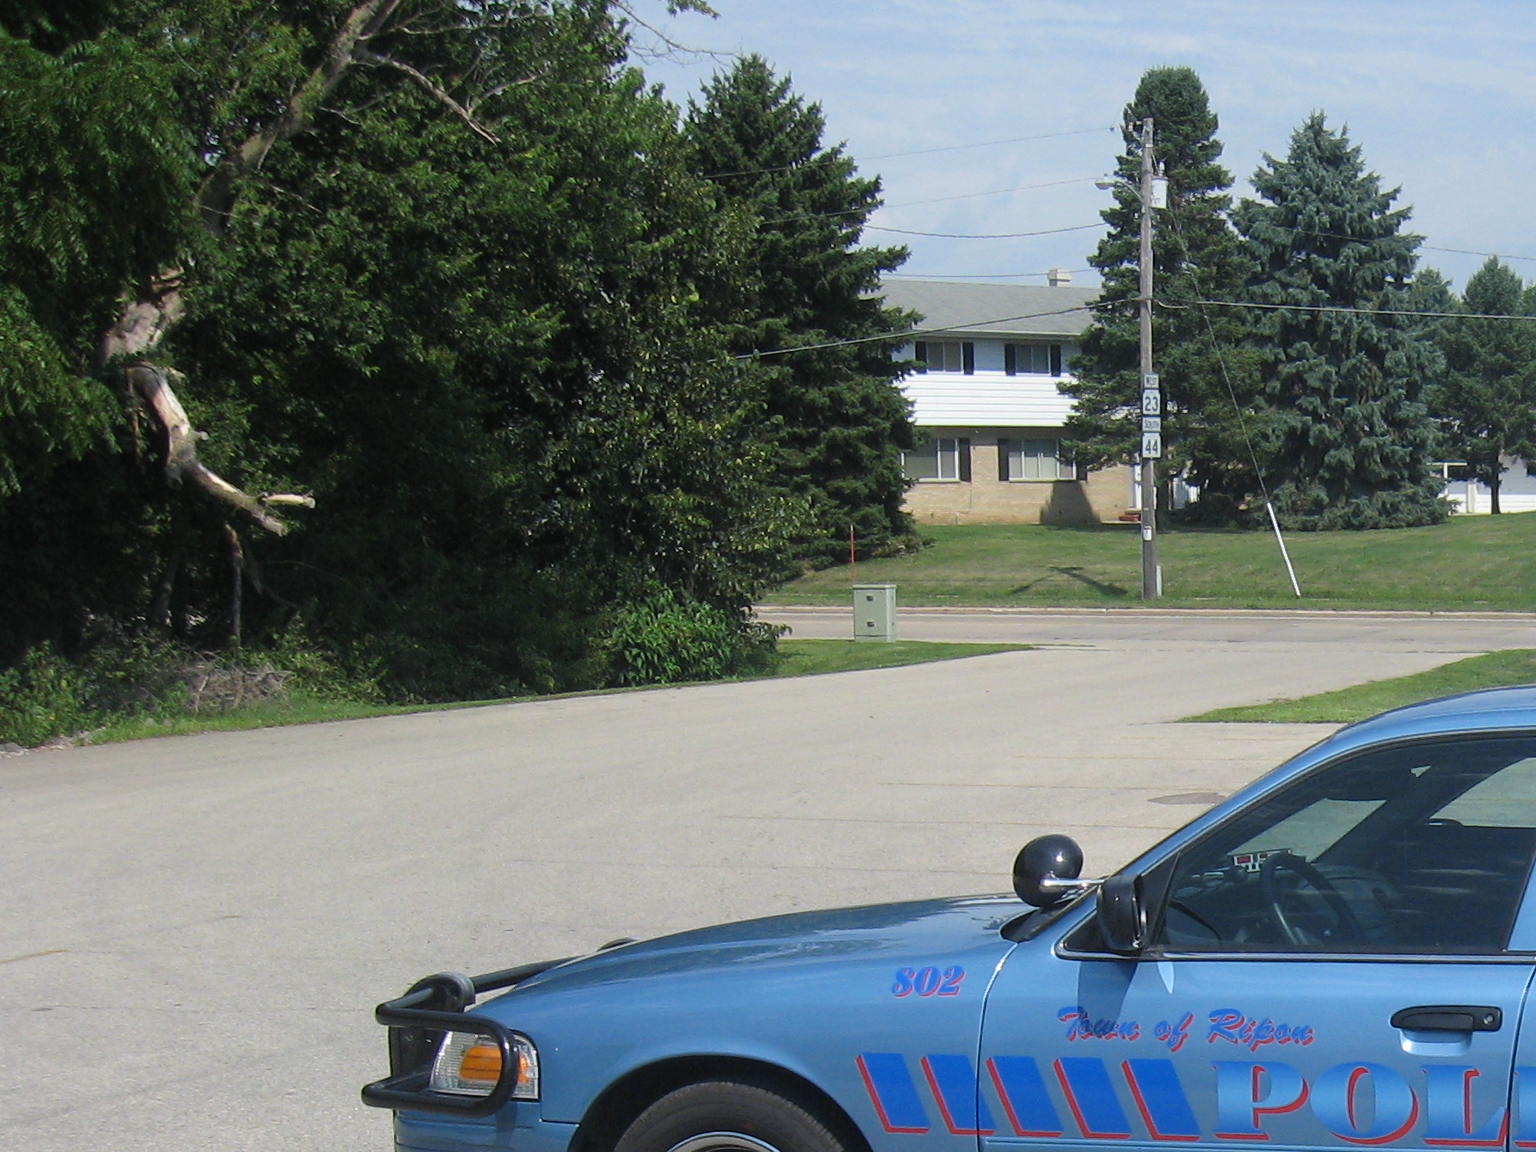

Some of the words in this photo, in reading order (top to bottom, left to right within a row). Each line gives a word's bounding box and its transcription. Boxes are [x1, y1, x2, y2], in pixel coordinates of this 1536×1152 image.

[1145, 396, 1158, 411] 23
[1145, 439, 1158, 454] 44
[892, 965, 966, 998] 802
[1058, 1005, 1141, 1041] Town
[1154, 1011, 1195, 1053] of
[1207, 1007, 1316, 1052] Ripon
